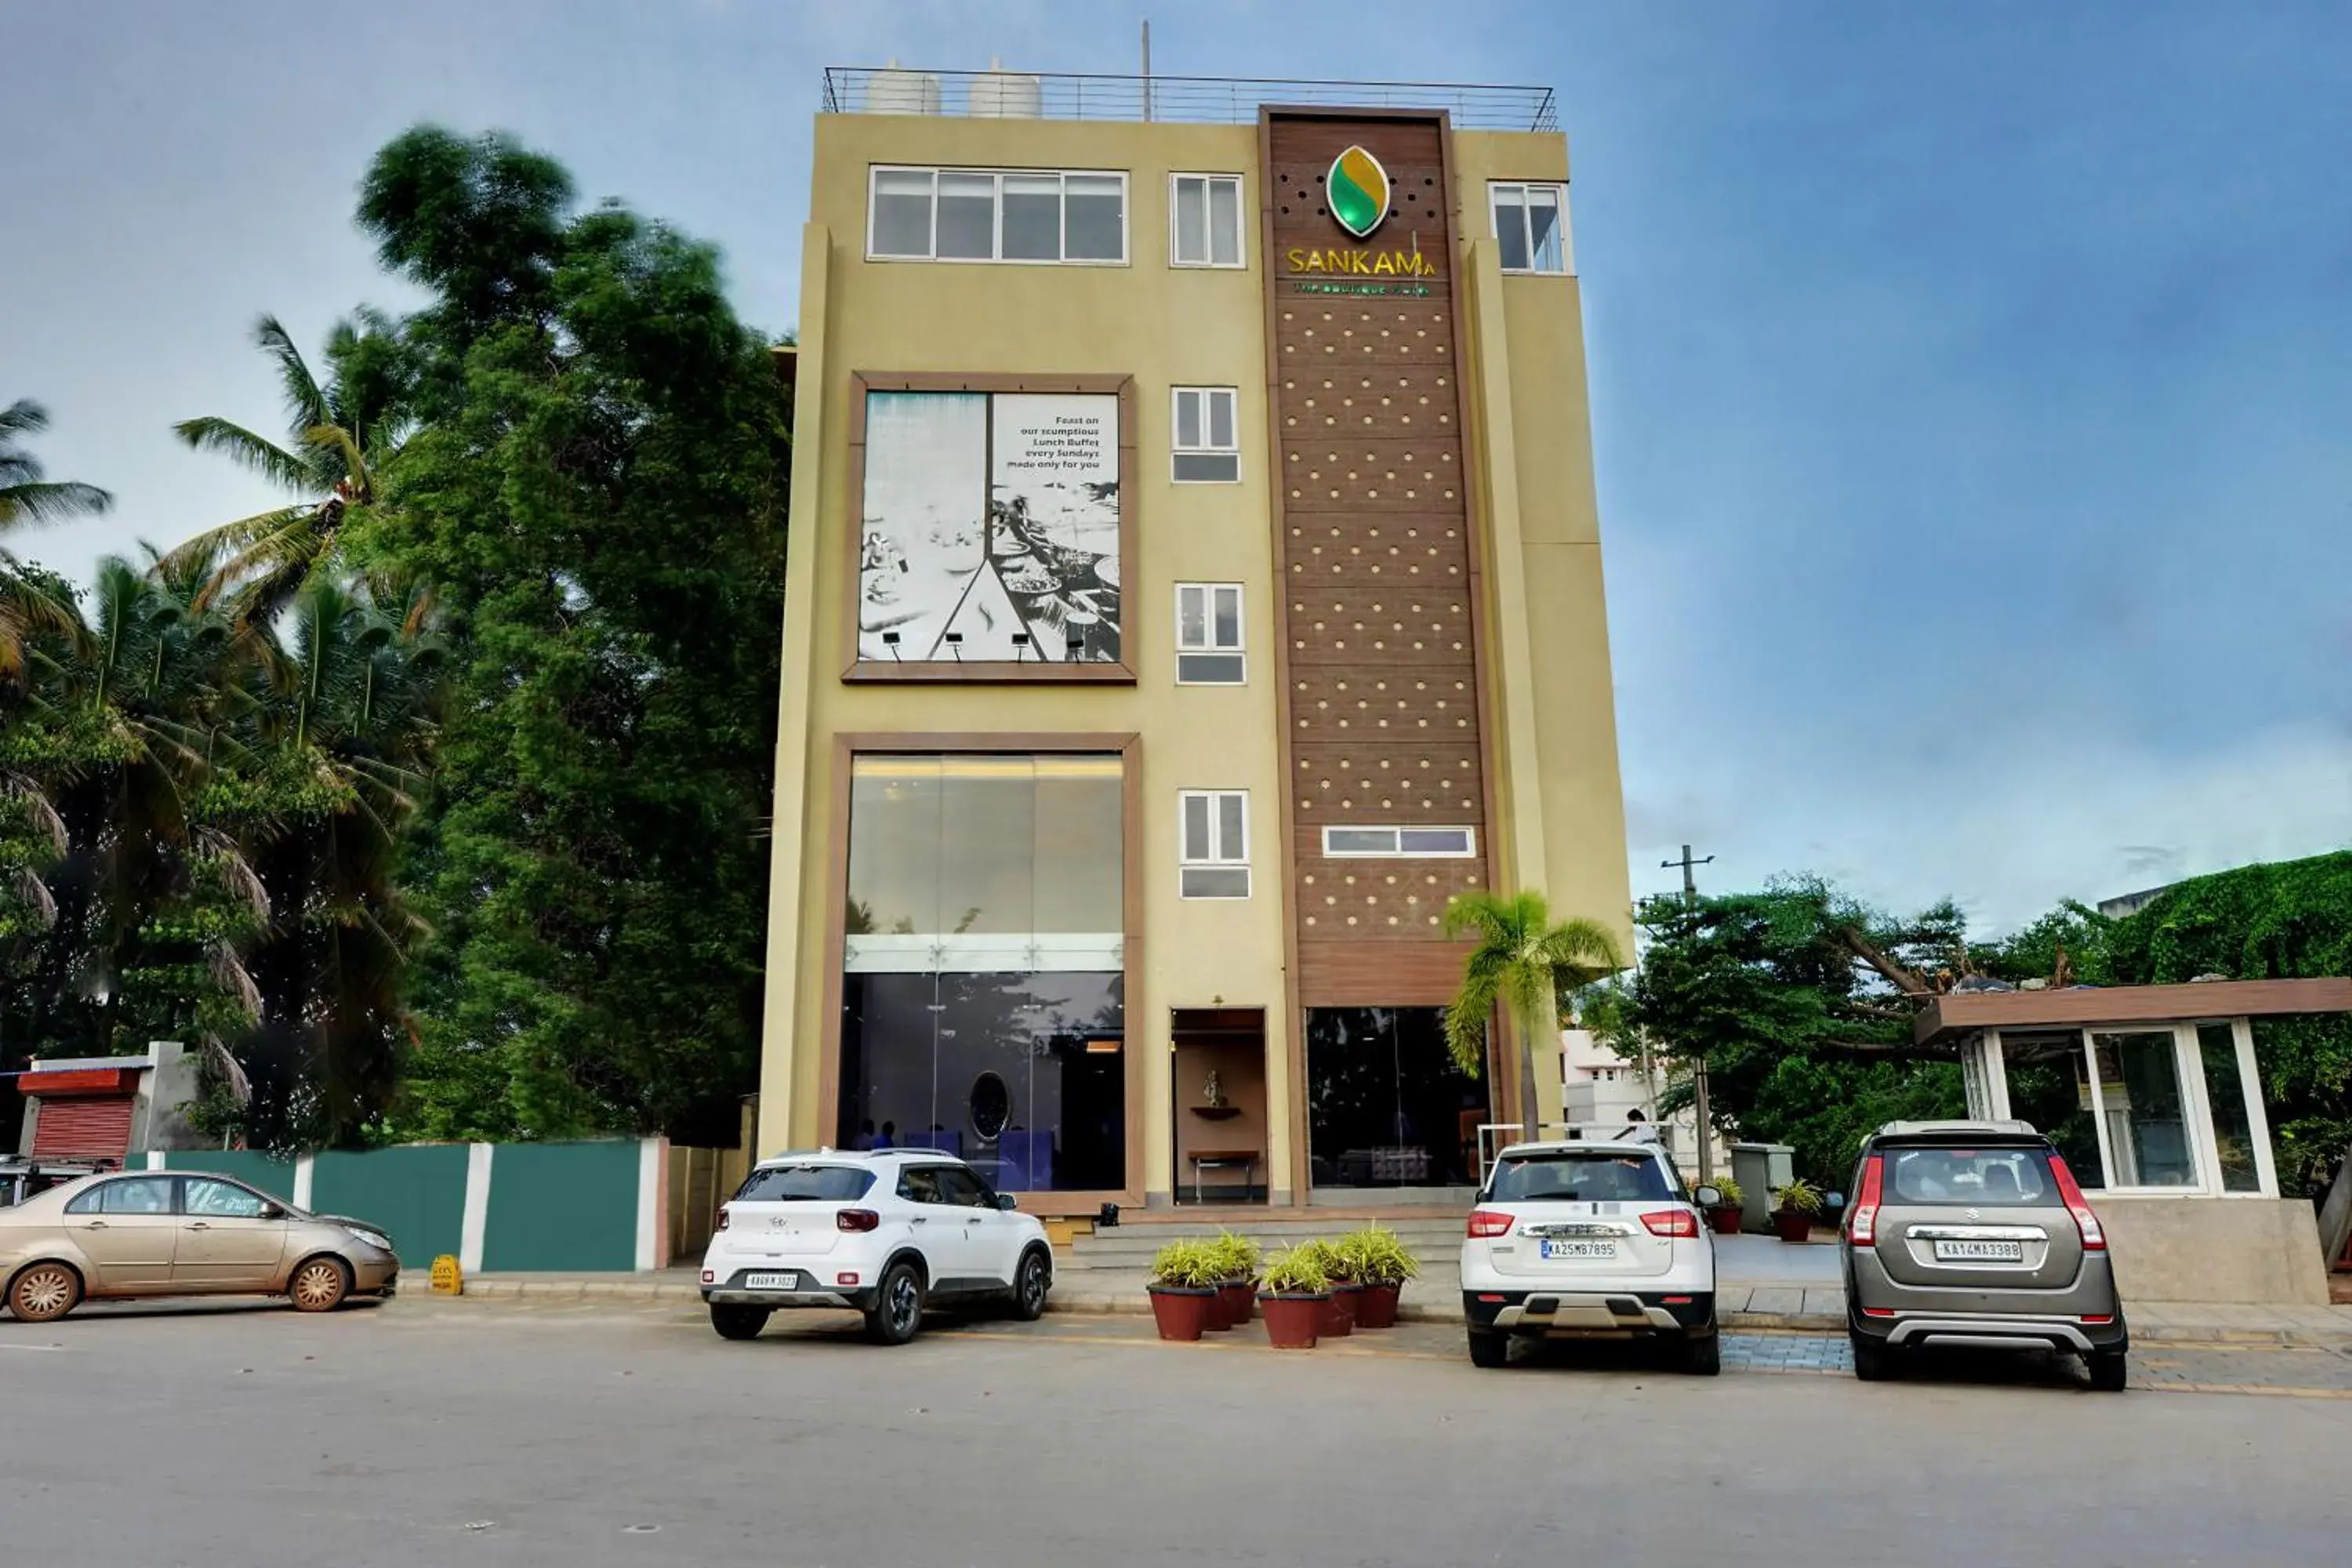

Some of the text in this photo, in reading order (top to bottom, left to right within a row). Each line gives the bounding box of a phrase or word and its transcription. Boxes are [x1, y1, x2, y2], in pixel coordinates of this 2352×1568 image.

[1057, 449, 1099, 459] Sundays
[1037, 461, 1061, 470] only
[1080, 462, 1099, 470] you
